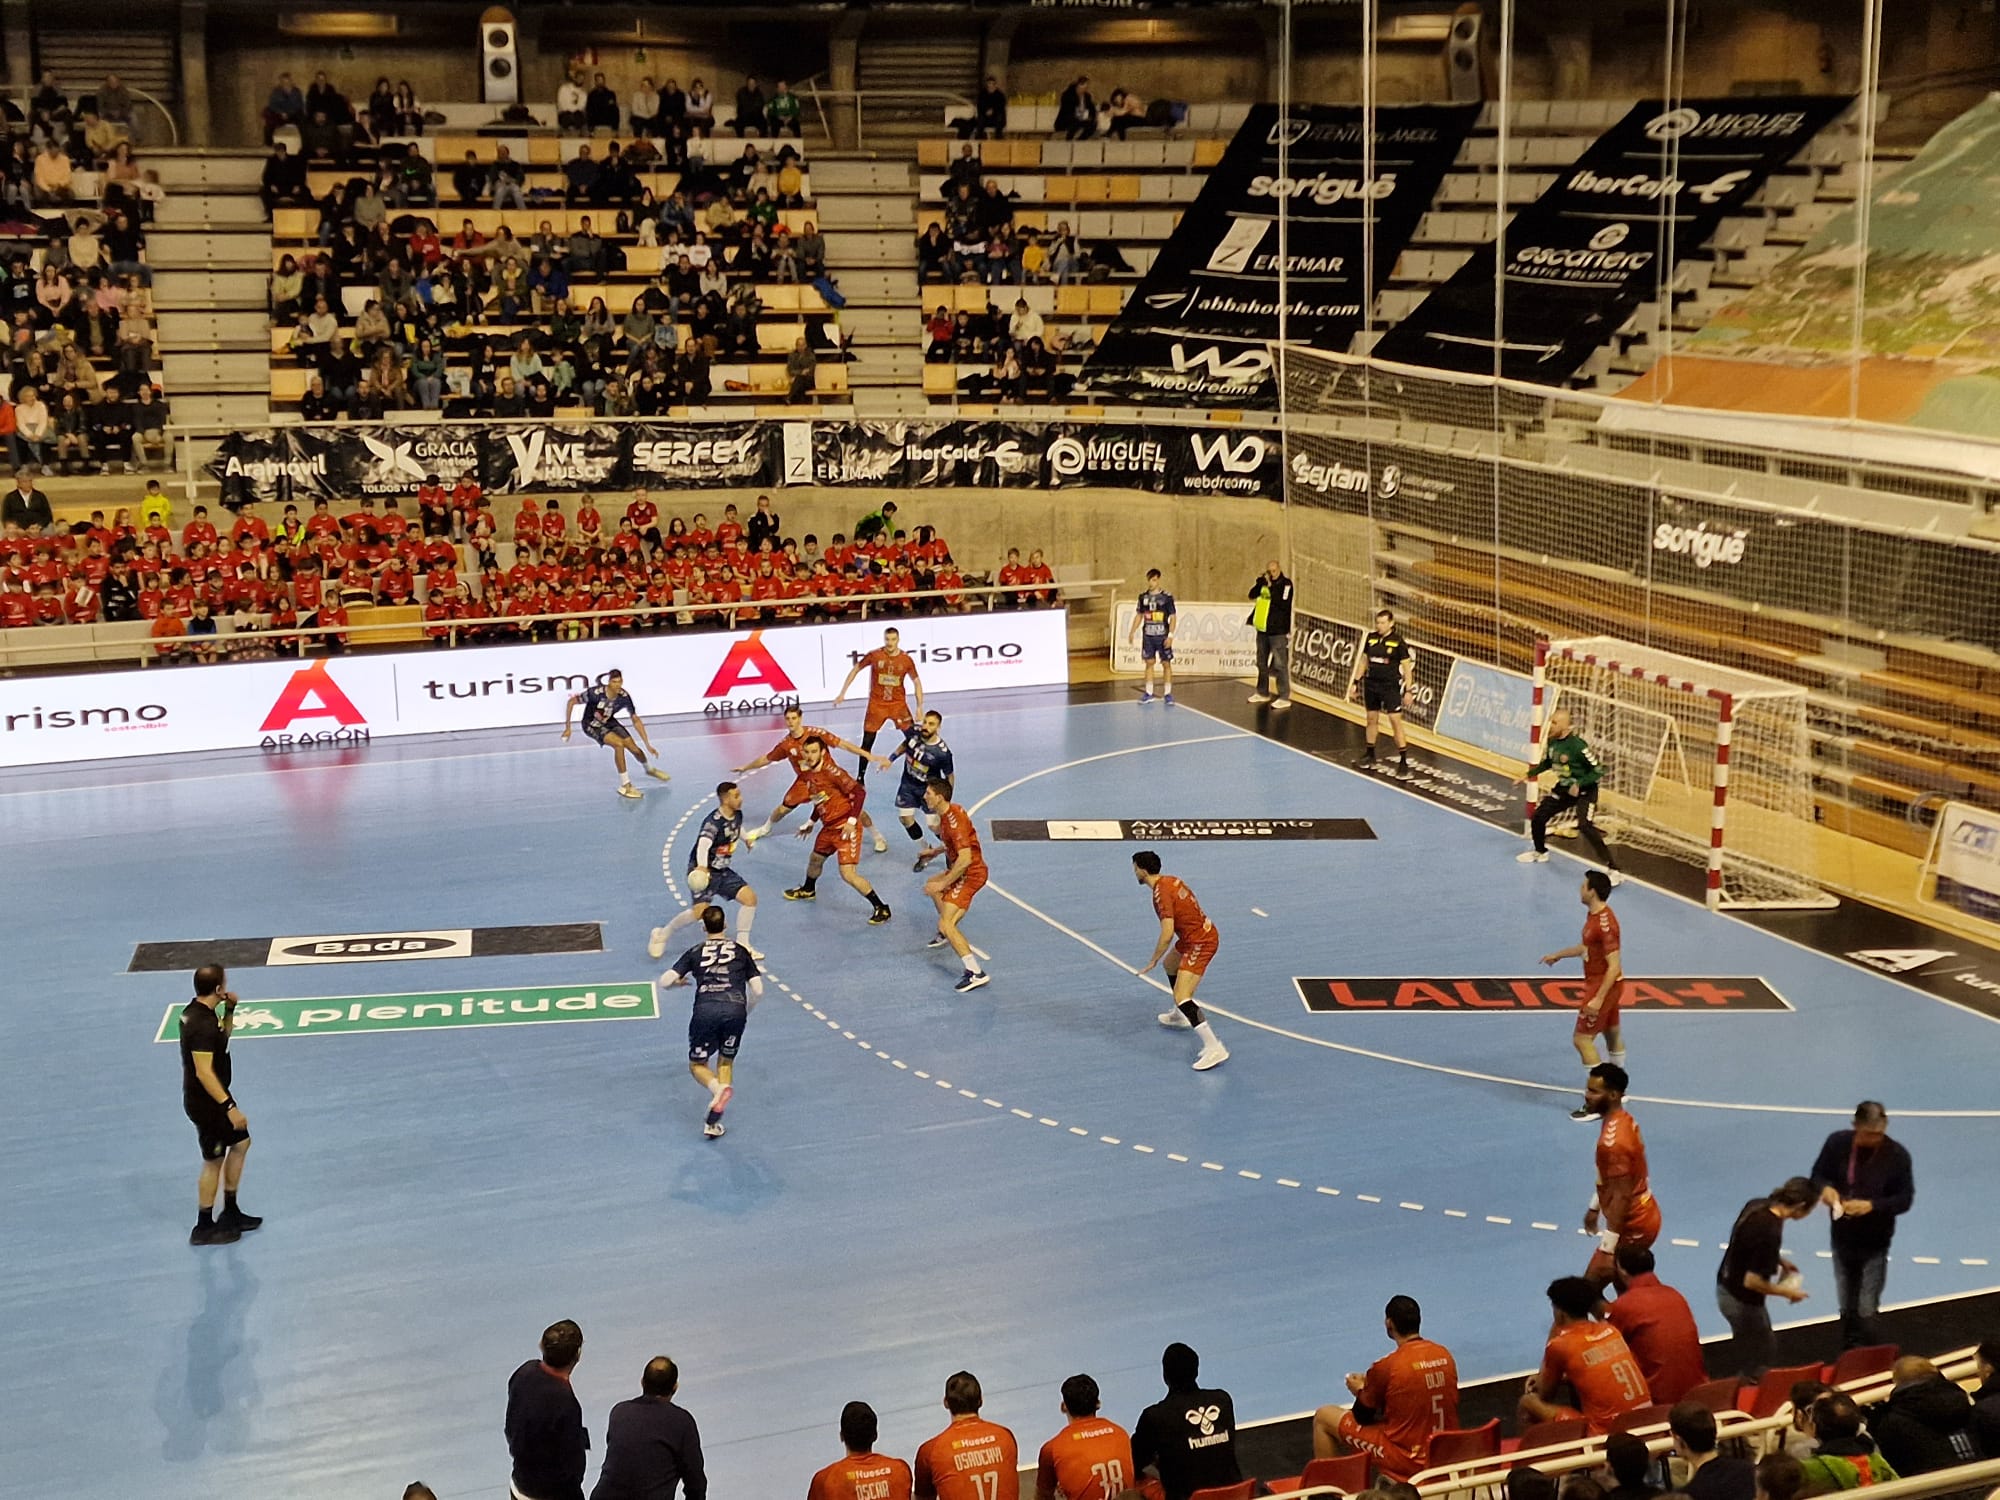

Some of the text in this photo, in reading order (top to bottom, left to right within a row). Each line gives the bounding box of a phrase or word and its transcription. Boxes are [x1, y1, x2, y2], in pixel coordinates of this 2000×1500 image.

[1198, 295, 1360, 317] abbahotels.com
[415, 441, 477, 457] GRACIA
[632, 440, 753, 465] SERFEY
[1087, 442, 1167, 463] MIGUEL
[545, 466, 607, 479] HUESCA
[1184, 474, 1261, 492] webdreams
[1296, 462, 1369, 492] seytam
[361, 484, 400, 494] TOLDOS
[1294, 629, 1355, 668] uesca
[703, 693, 800, 713] ARAGÓN
[5, 704, 168, 731] rismo
[260, 726, 371, 748] ARAGÓN
[1131, 820, 1313, 829] Ayuntamiento
[1172, 827, 1272, 835] Huesca
[314, 939, 427, 955] Bada
[700, 944, 737, 967] 55
[298, 991, 642, 1028] plenitude
[1611, 1359, 1645, 1400] 91
[1431, 1394, 1445, 1432] 5
[961, 1434, 996, 1448] Huesca
[1081, 1427, 1114, 1439] Huesca
[1188, 1430, 1229, 1449] hummel
[856, 1466, 891, 1480] Huesca
[1091, 1459, 1124, 1499] 38
[970, 1470, 998, 1500] 17
